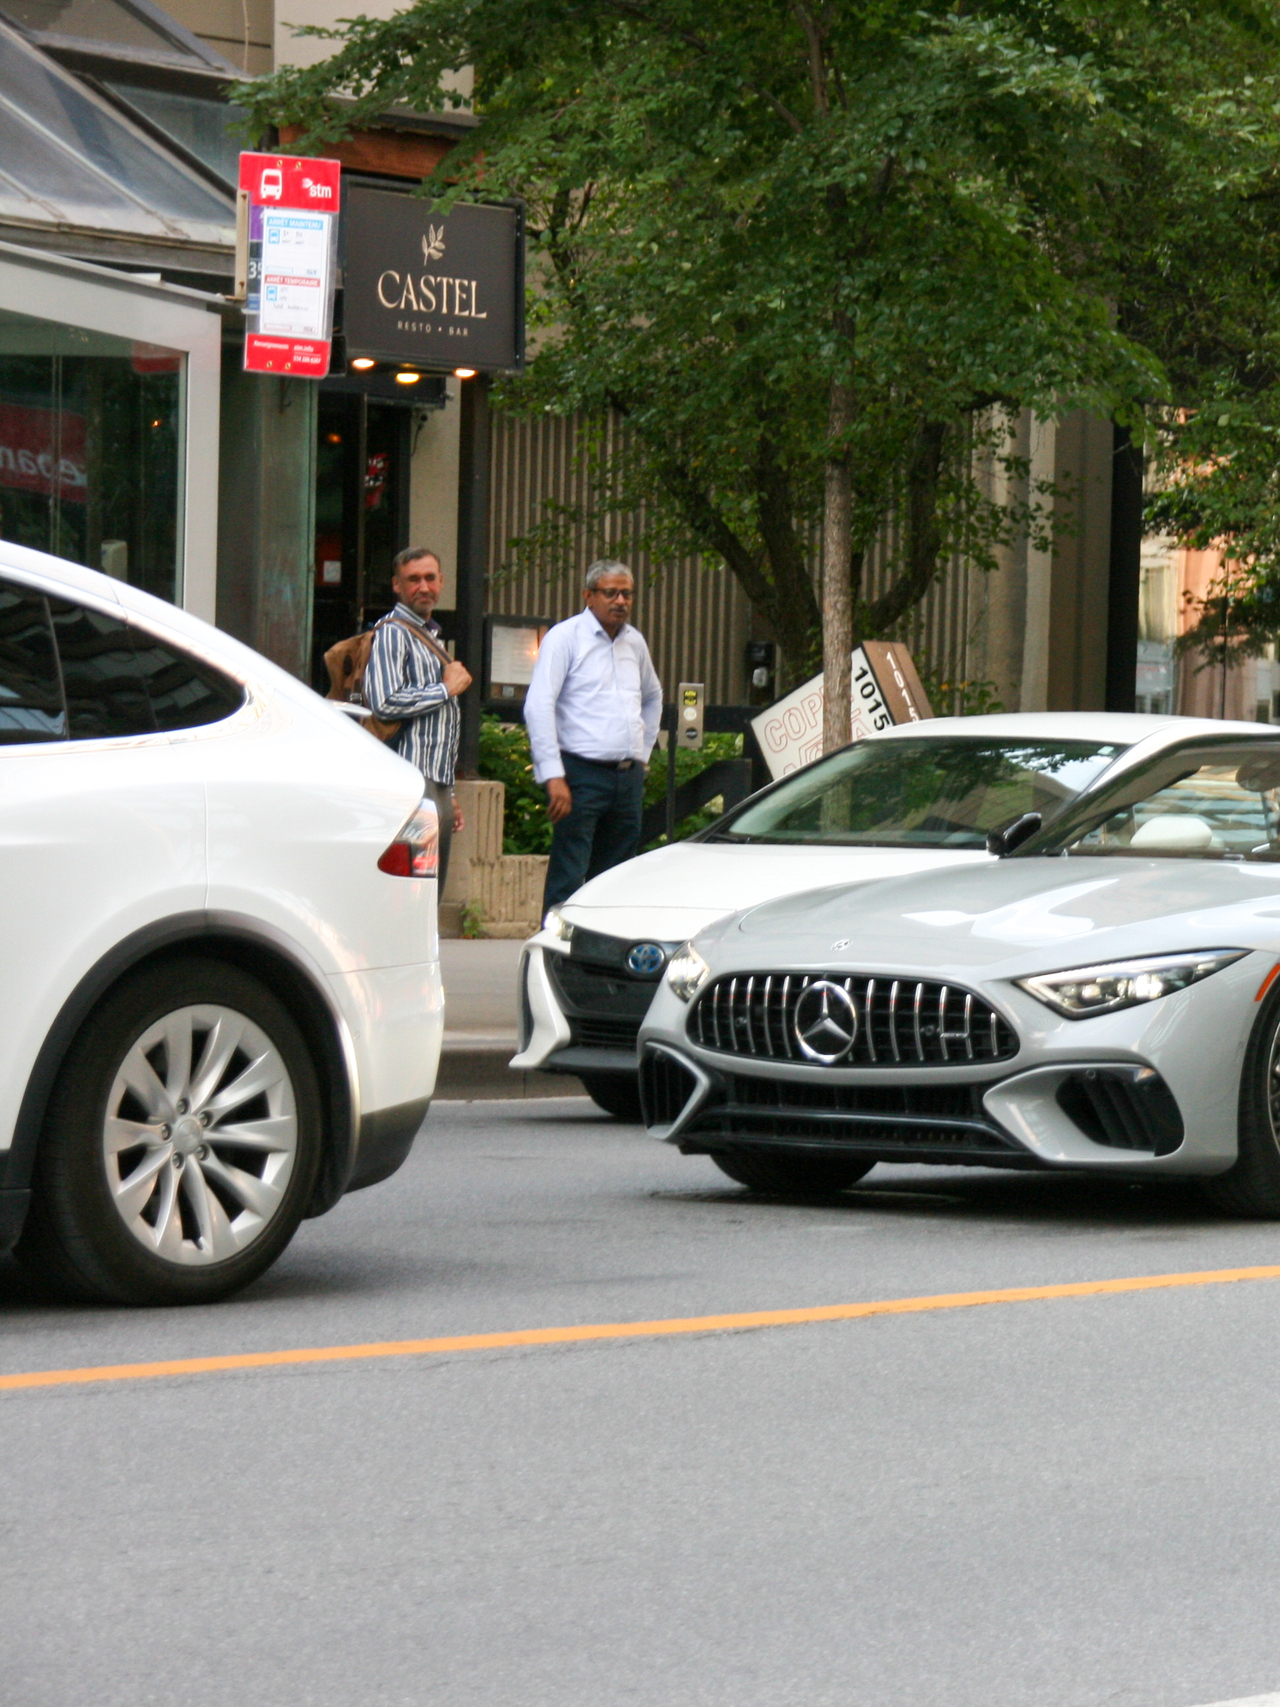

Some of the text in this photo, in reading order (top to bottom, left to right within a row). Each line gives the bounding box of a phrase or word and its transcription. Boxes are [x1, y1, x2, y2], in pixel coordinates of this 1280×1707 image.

[309, 183, 333, 199] stm
[377, 269, 488, 319] CASTEL
[397, 320, 469, 336] RESTO BAR
[854, 666, 890, 731] 1015
[886, 651, 919, 722] 1015
